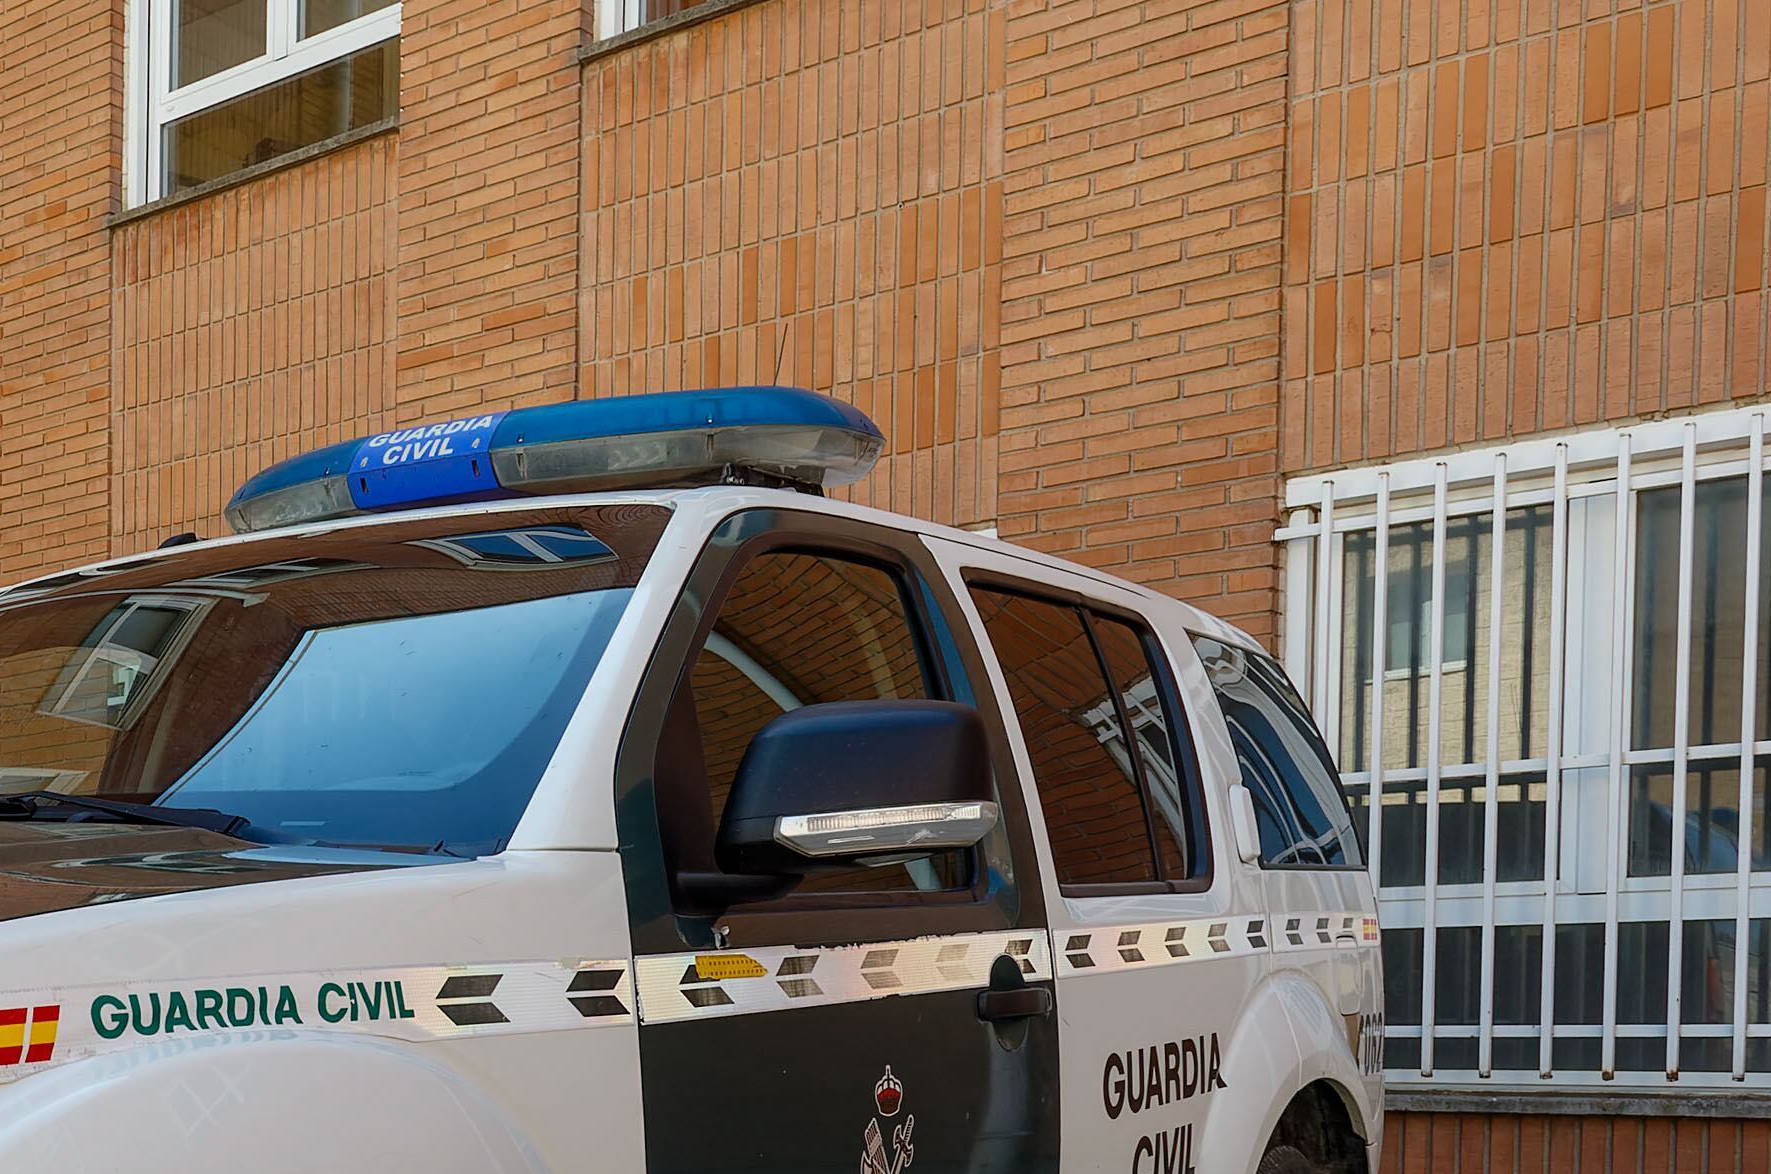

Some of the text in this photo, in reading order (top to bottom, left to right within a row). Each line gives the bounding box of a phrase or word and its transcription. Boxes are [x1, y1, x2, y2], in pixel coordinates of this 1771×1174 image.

[368, 415, 493, 448] GUARDIA
[382, 436, 454, 465] CIVIL
[90, 980, 416, 1040] GUARDIA CIVIL
[1102, 1032, 1228, 1120] GUARDIA
